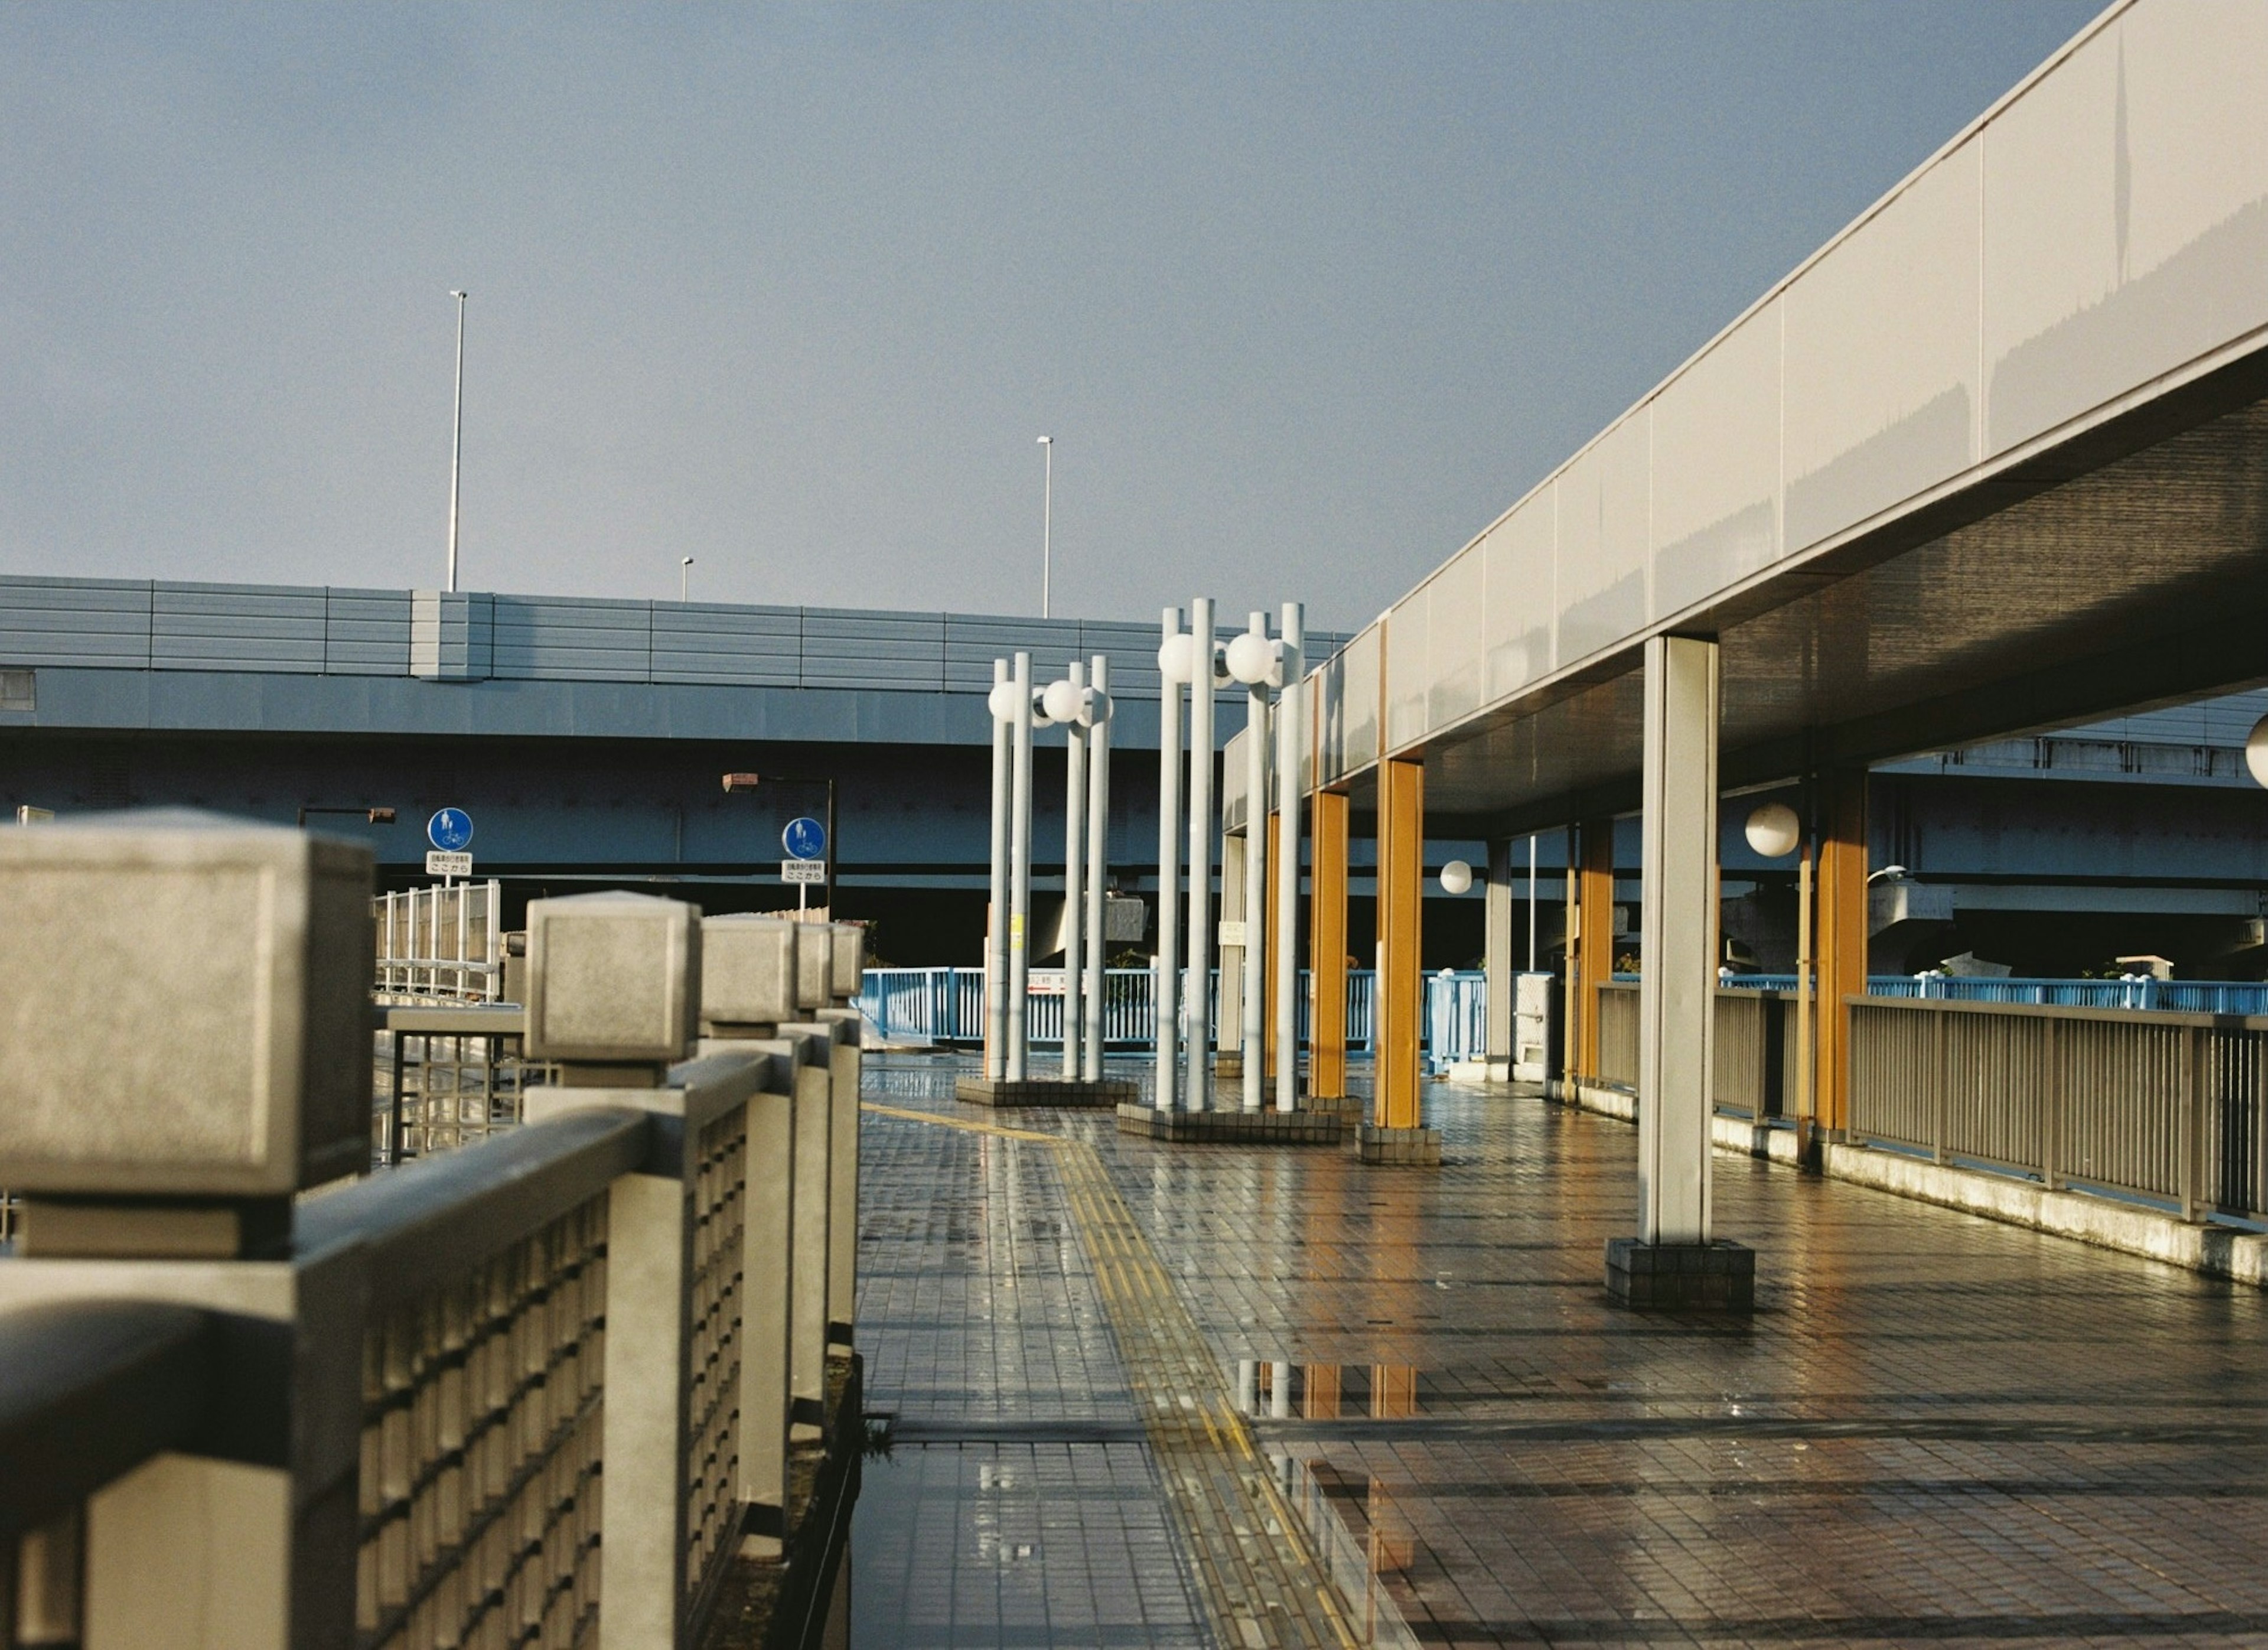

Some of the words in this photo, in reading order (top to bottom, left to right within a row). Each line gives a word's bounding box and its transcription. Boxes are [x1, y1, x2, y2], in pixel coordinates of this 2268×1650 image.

[432, 863, 468, 873] ここから
[787, 871, 821, 880] ここから
